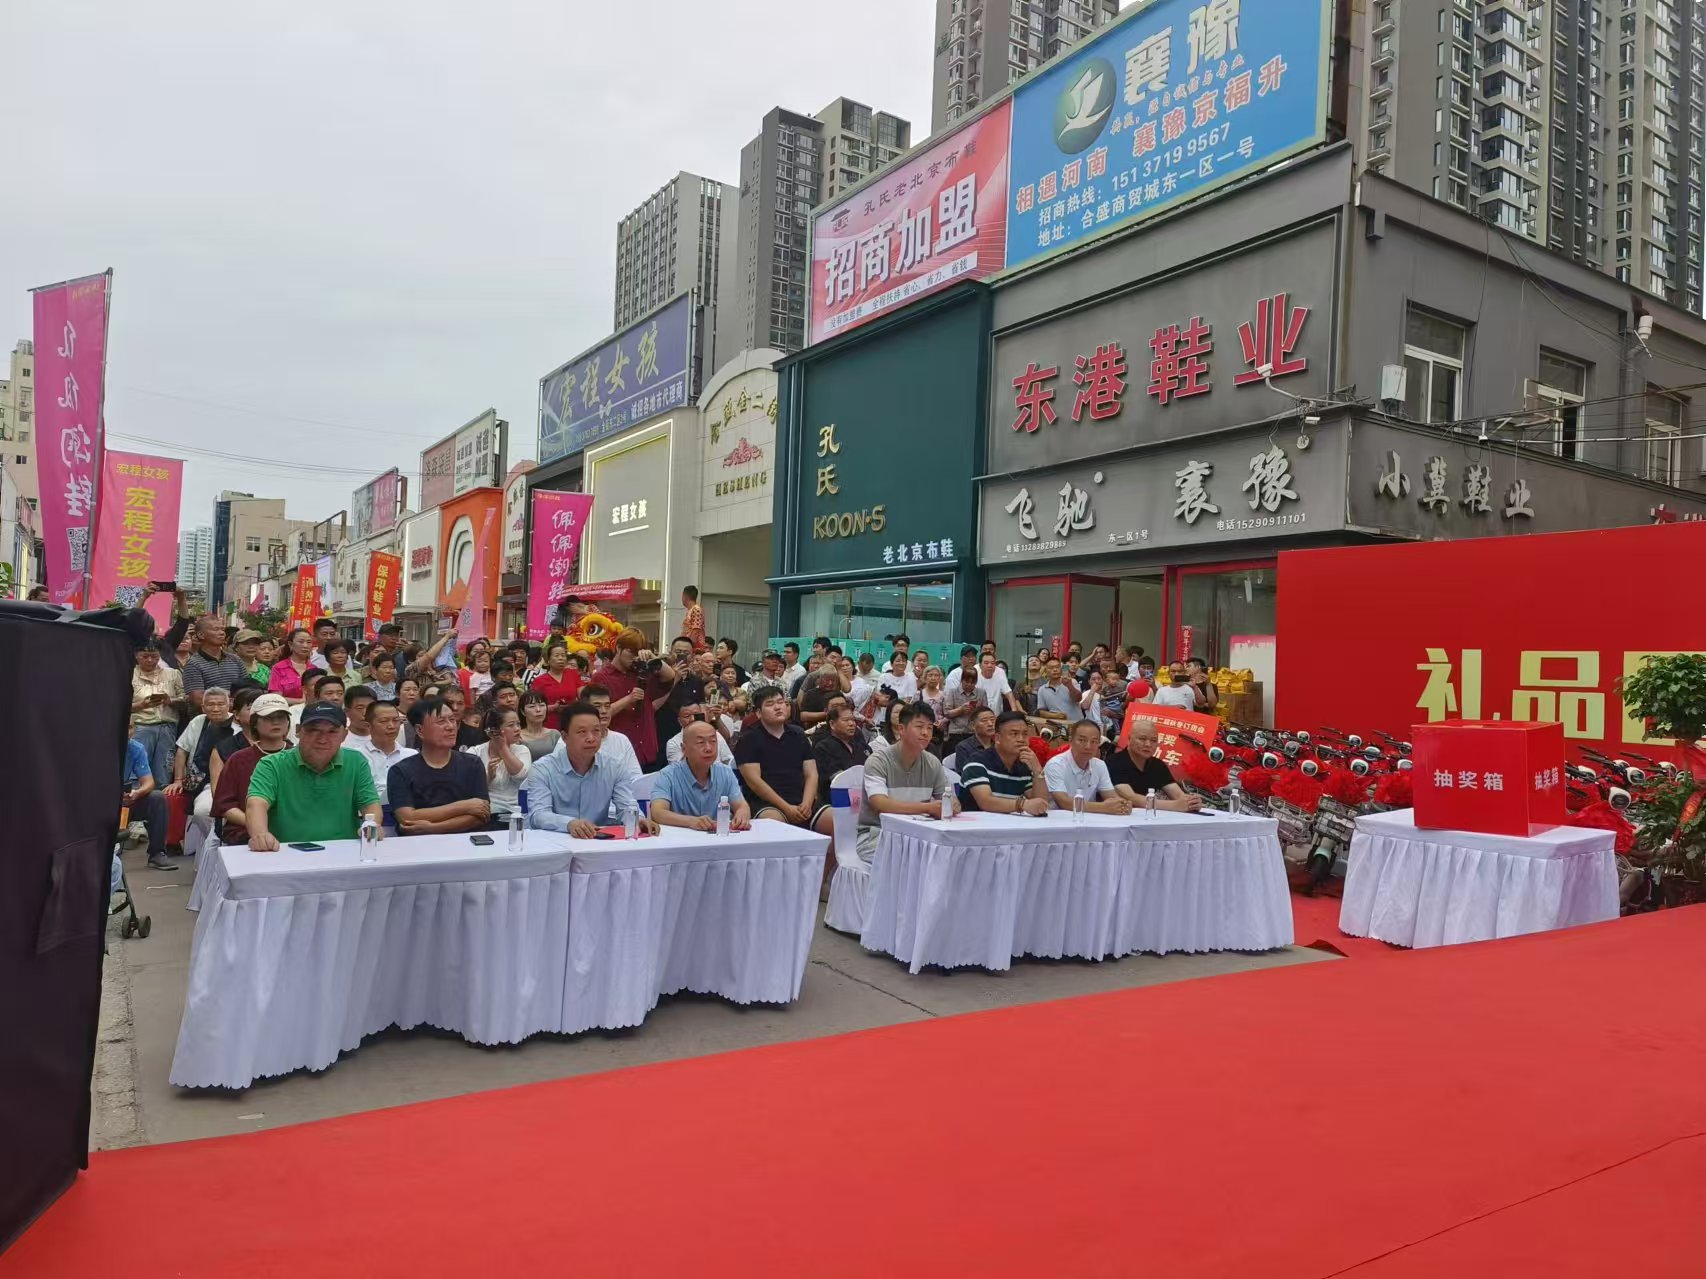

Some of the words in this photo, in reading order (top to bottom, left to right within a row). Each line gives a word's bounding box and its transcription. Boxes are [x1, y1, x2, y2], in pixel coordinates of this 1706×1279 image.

[1124, 0, 1241, 105] 襄豫
[1016, 147, 1108, 215] 相遇河南
[1132, 55, 1287, 158] 襄豫京福升
[864, 141, 977, 216] 孔氏老北京布鞋
[1080, 136, 1255, 230] 合盛商贸城东一区一号
[825, 172, 978, 307] 招商加盟
[1011, 292, 1309, 433] 东港鞋业
[116, 463, 169, 481] 宏程女孩
[816, 424, 842, 497] 孔氏
[1004, 481, 1096, 540] 飞驰
[1174, 446, 1299, 525] 襄豫
[116, 487, 156, 579] 宏程女孩
[612, 498, 648, 525] 宏程女孩
[883, 538, 954, 564] 老北京布鞋
[1434, 769, 1504, 791] 抽奖箱
[1535, 766, 1559, 790] 抽奖箱
